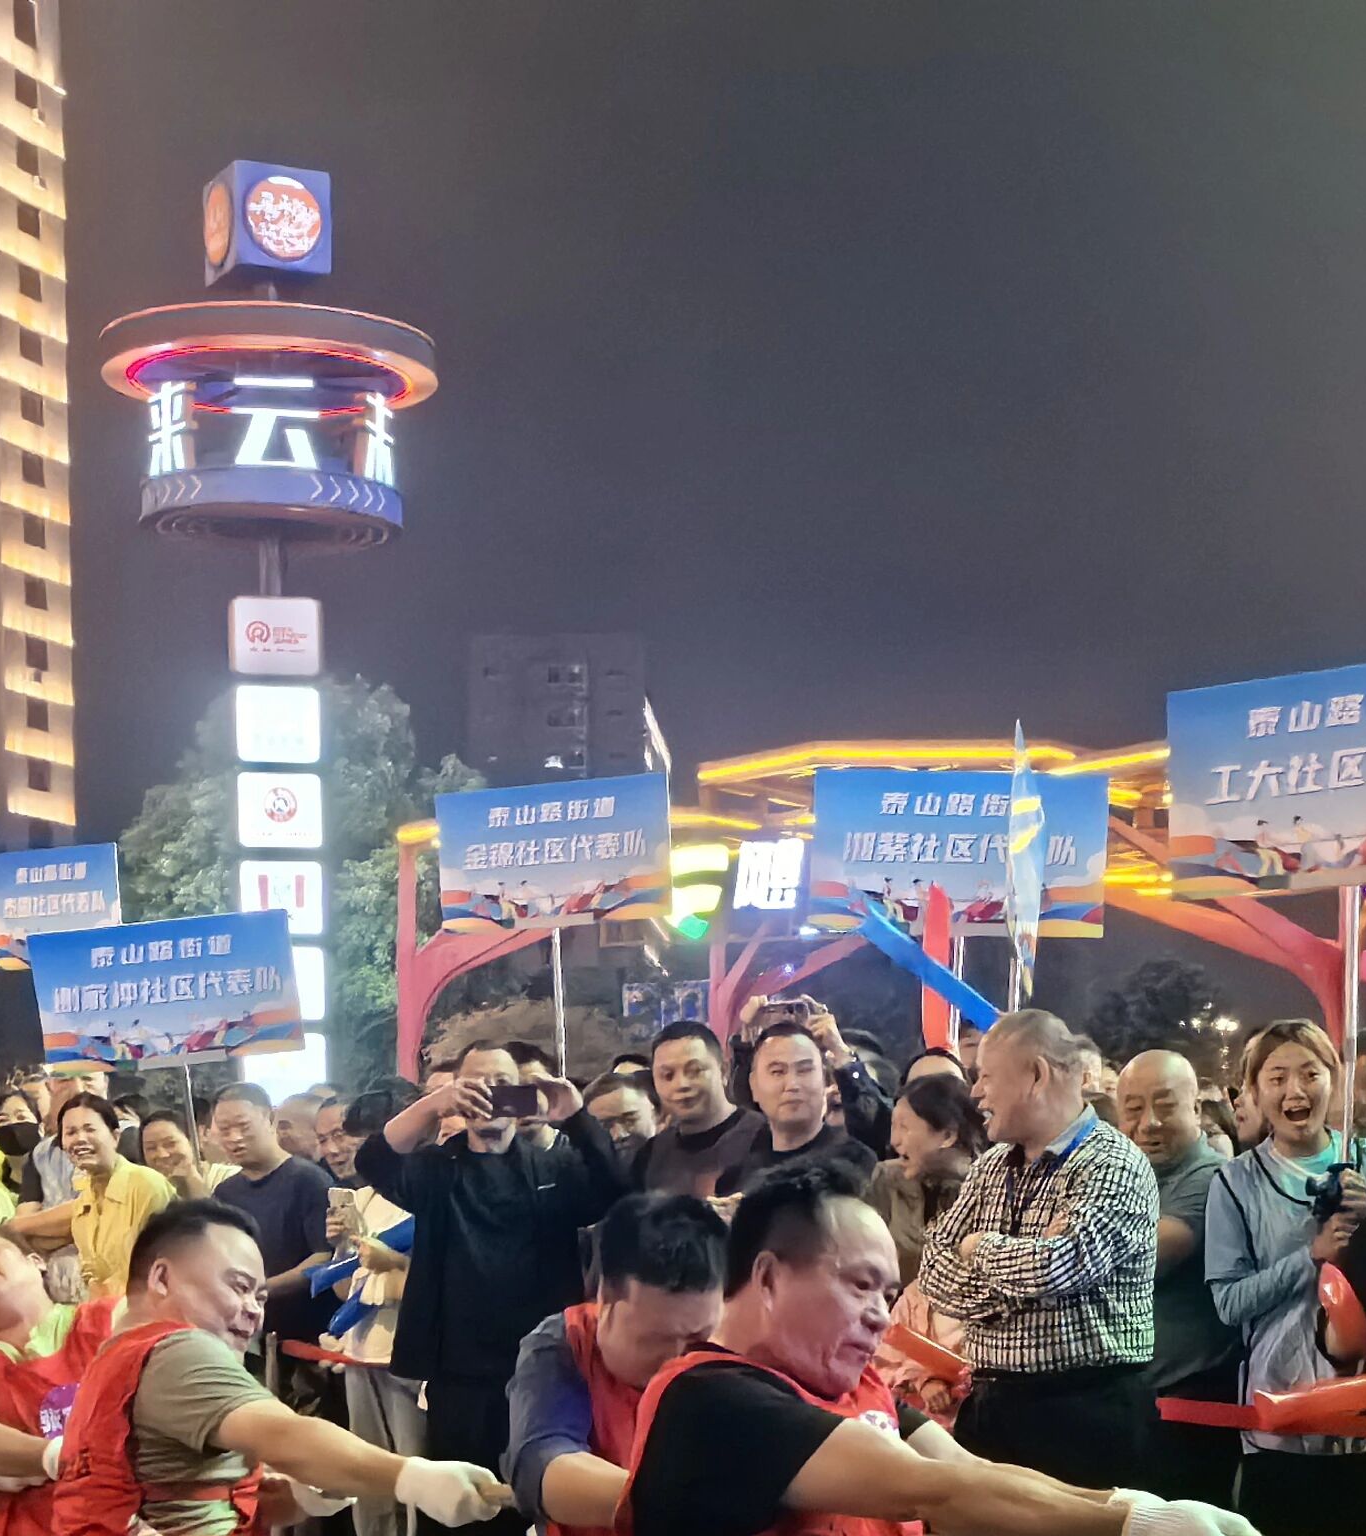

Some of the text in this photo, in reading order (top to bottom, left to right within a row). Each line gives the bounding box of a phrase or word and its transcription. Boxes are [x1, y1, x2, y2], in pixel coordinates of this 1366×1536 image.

[488, 796, 615, 828] 泰山路街道
[879, 792, 1013, 817] 泰山路街
[91, 935, 231, 968] 泰山路街道
